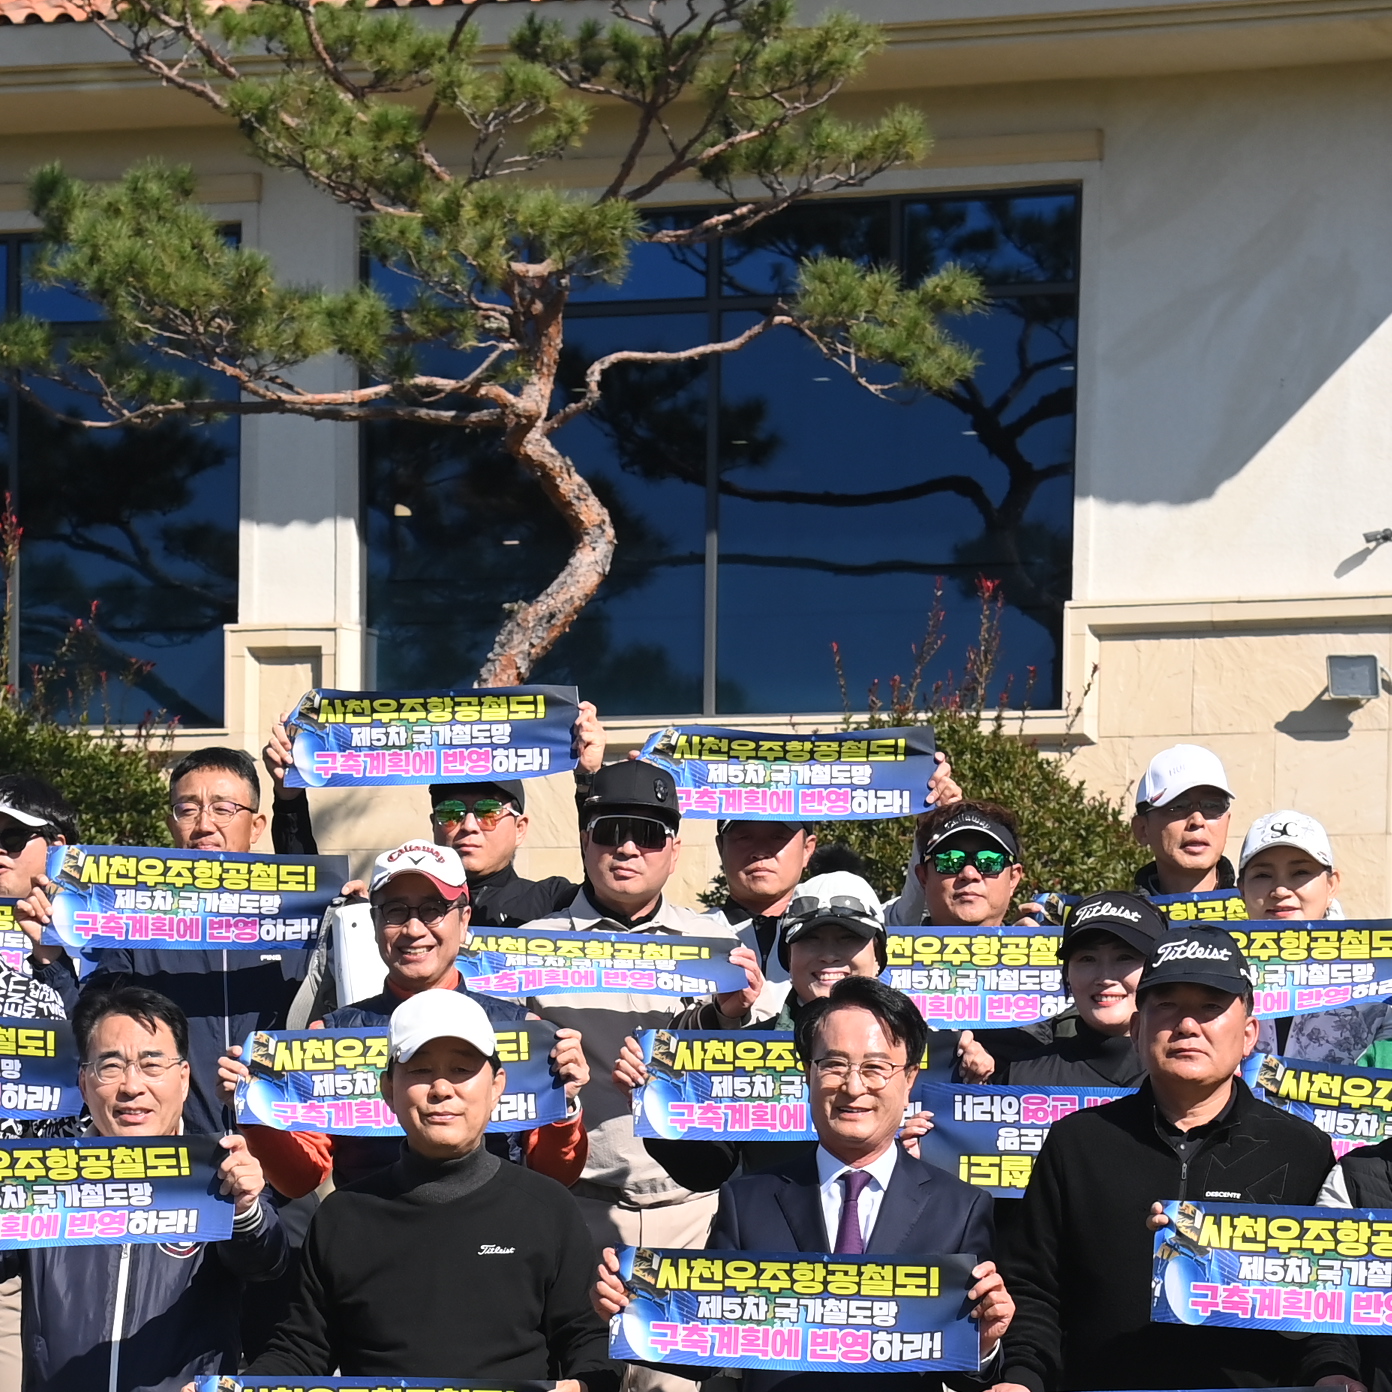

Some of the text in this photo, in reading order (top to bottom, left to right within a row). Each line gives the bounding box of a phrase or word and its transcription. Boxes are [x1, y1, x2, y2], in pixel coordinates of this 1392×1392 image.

[317, 694, 545, 723] 사천우주항공철도!
[350, 724, 512, 747] 제5차 국가철도망
[673, 735, 905, 761] 사천우주항공철도!
[313, 750, 438, 777] 구축계획에
[707, 764, 872, 786] 제5차 국가철도망
[679, 788, 794, 814] 구축계획에
[387, 840, 446, 866] Callaway
[81, 857, 316, 892] 사천우주항공철도!
[115, 890, 281, 914] 제5차 국가철도망
[1070, 901, 1142, 928] Titleist
[74, 912, 200, 940] 구축계획에
[1152, 939, 1230, 967] Titleist
[957, 968, 1061, 991] 국가철도망
[1264, 964, 1374, 985] 국가철도망
[311, 1074, 376, 1098] 제5차
[710, 1075, 774, 1098] 제5차
[668, 1102, 804, 1132] 구축계획에
[1313, 1108, 1378, 1137] 제5차
[33, 1183, 153, 1209] 국가철도망
[477, 1243, 516, 1256] Titleist
[656, 1258, 939, 1297] 사천우주항공철도!
[1239, 1260, 1310, 1284] 제5차
[697, 1294, 898, 1326] 제5차 국가철도망
[1190, 1282, 1343, 1322] 구축계획에
[649, 1322, 802, 1359] 구축계획에
